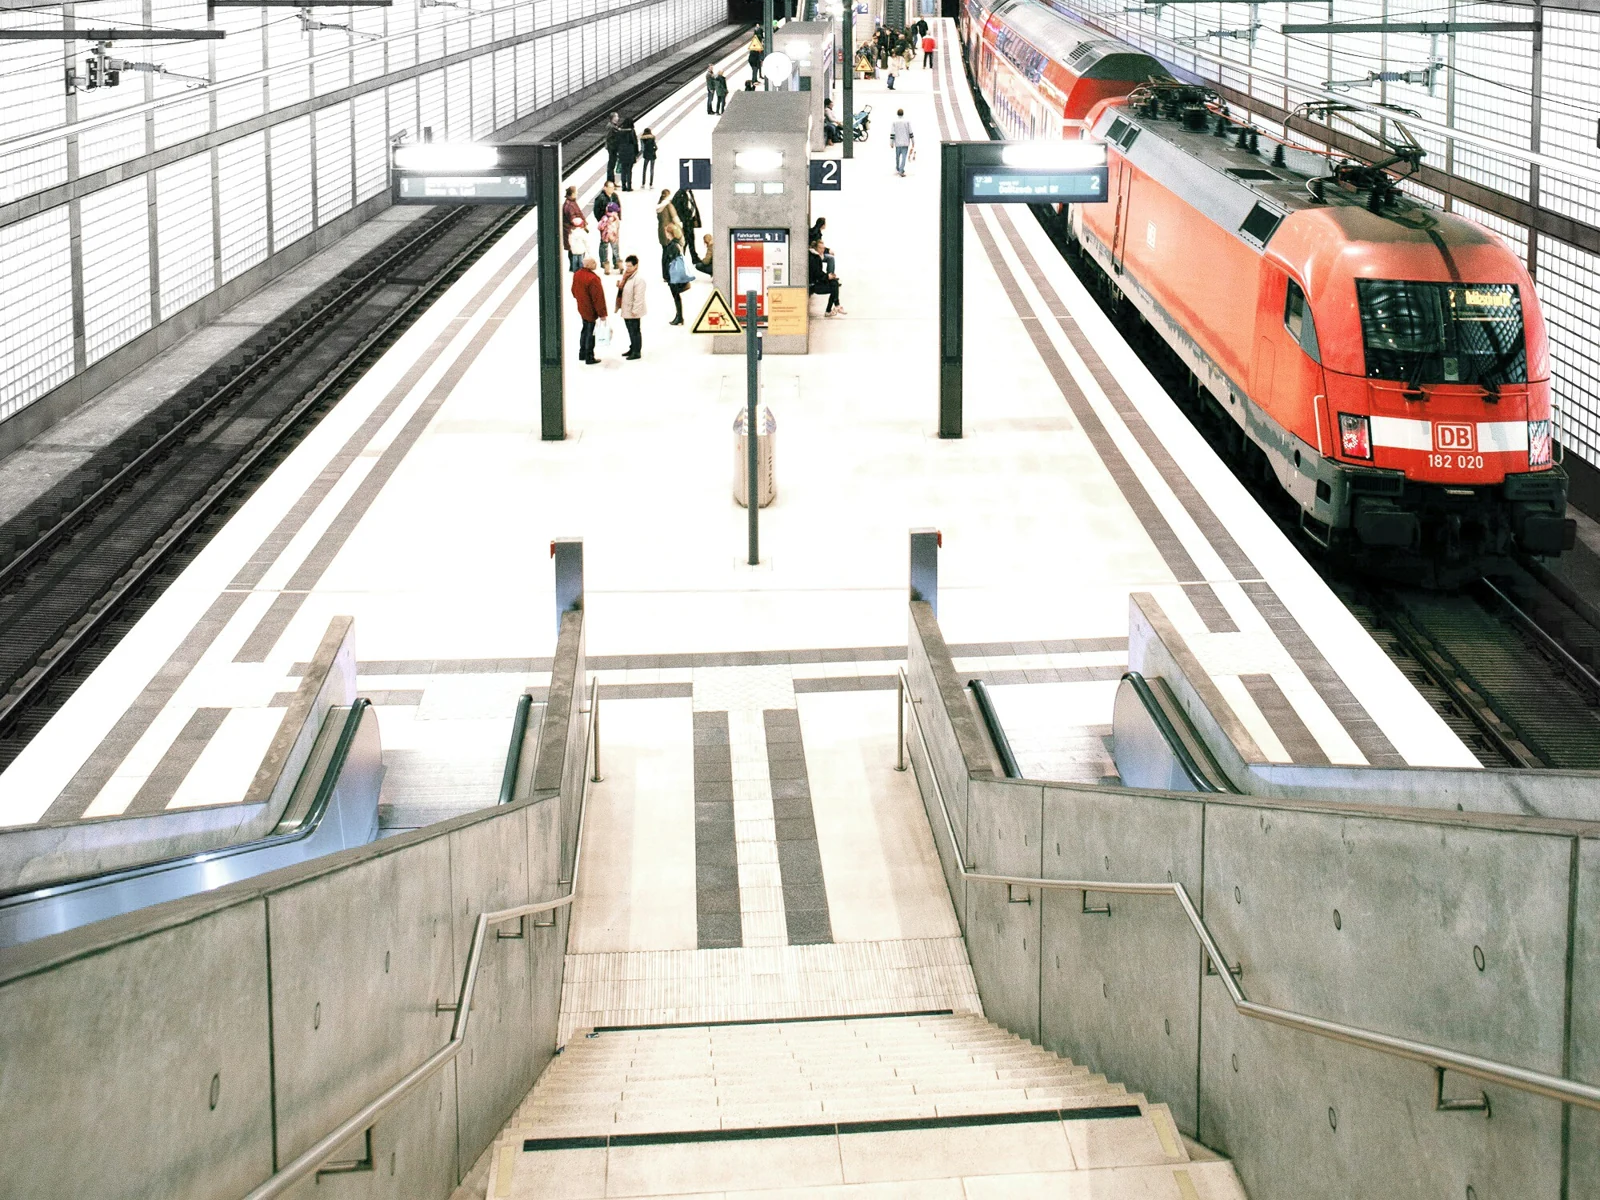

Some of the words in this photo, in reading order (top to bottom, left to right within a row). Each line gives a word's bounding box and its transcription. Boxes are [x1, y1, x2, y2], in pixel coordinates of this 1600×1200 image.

[861, 3, 868, 12] 2
[683, 159, 694, 183] 1
[822, 160, 837, 184] 2
[401, 178, 409, 193] 1
[1090, 175, 1100, 190] 2
[1440, 427, 1470, 447] DB
[1428, 454, 1453, 468] 182
[1457, 455, 1484, 469] 020
